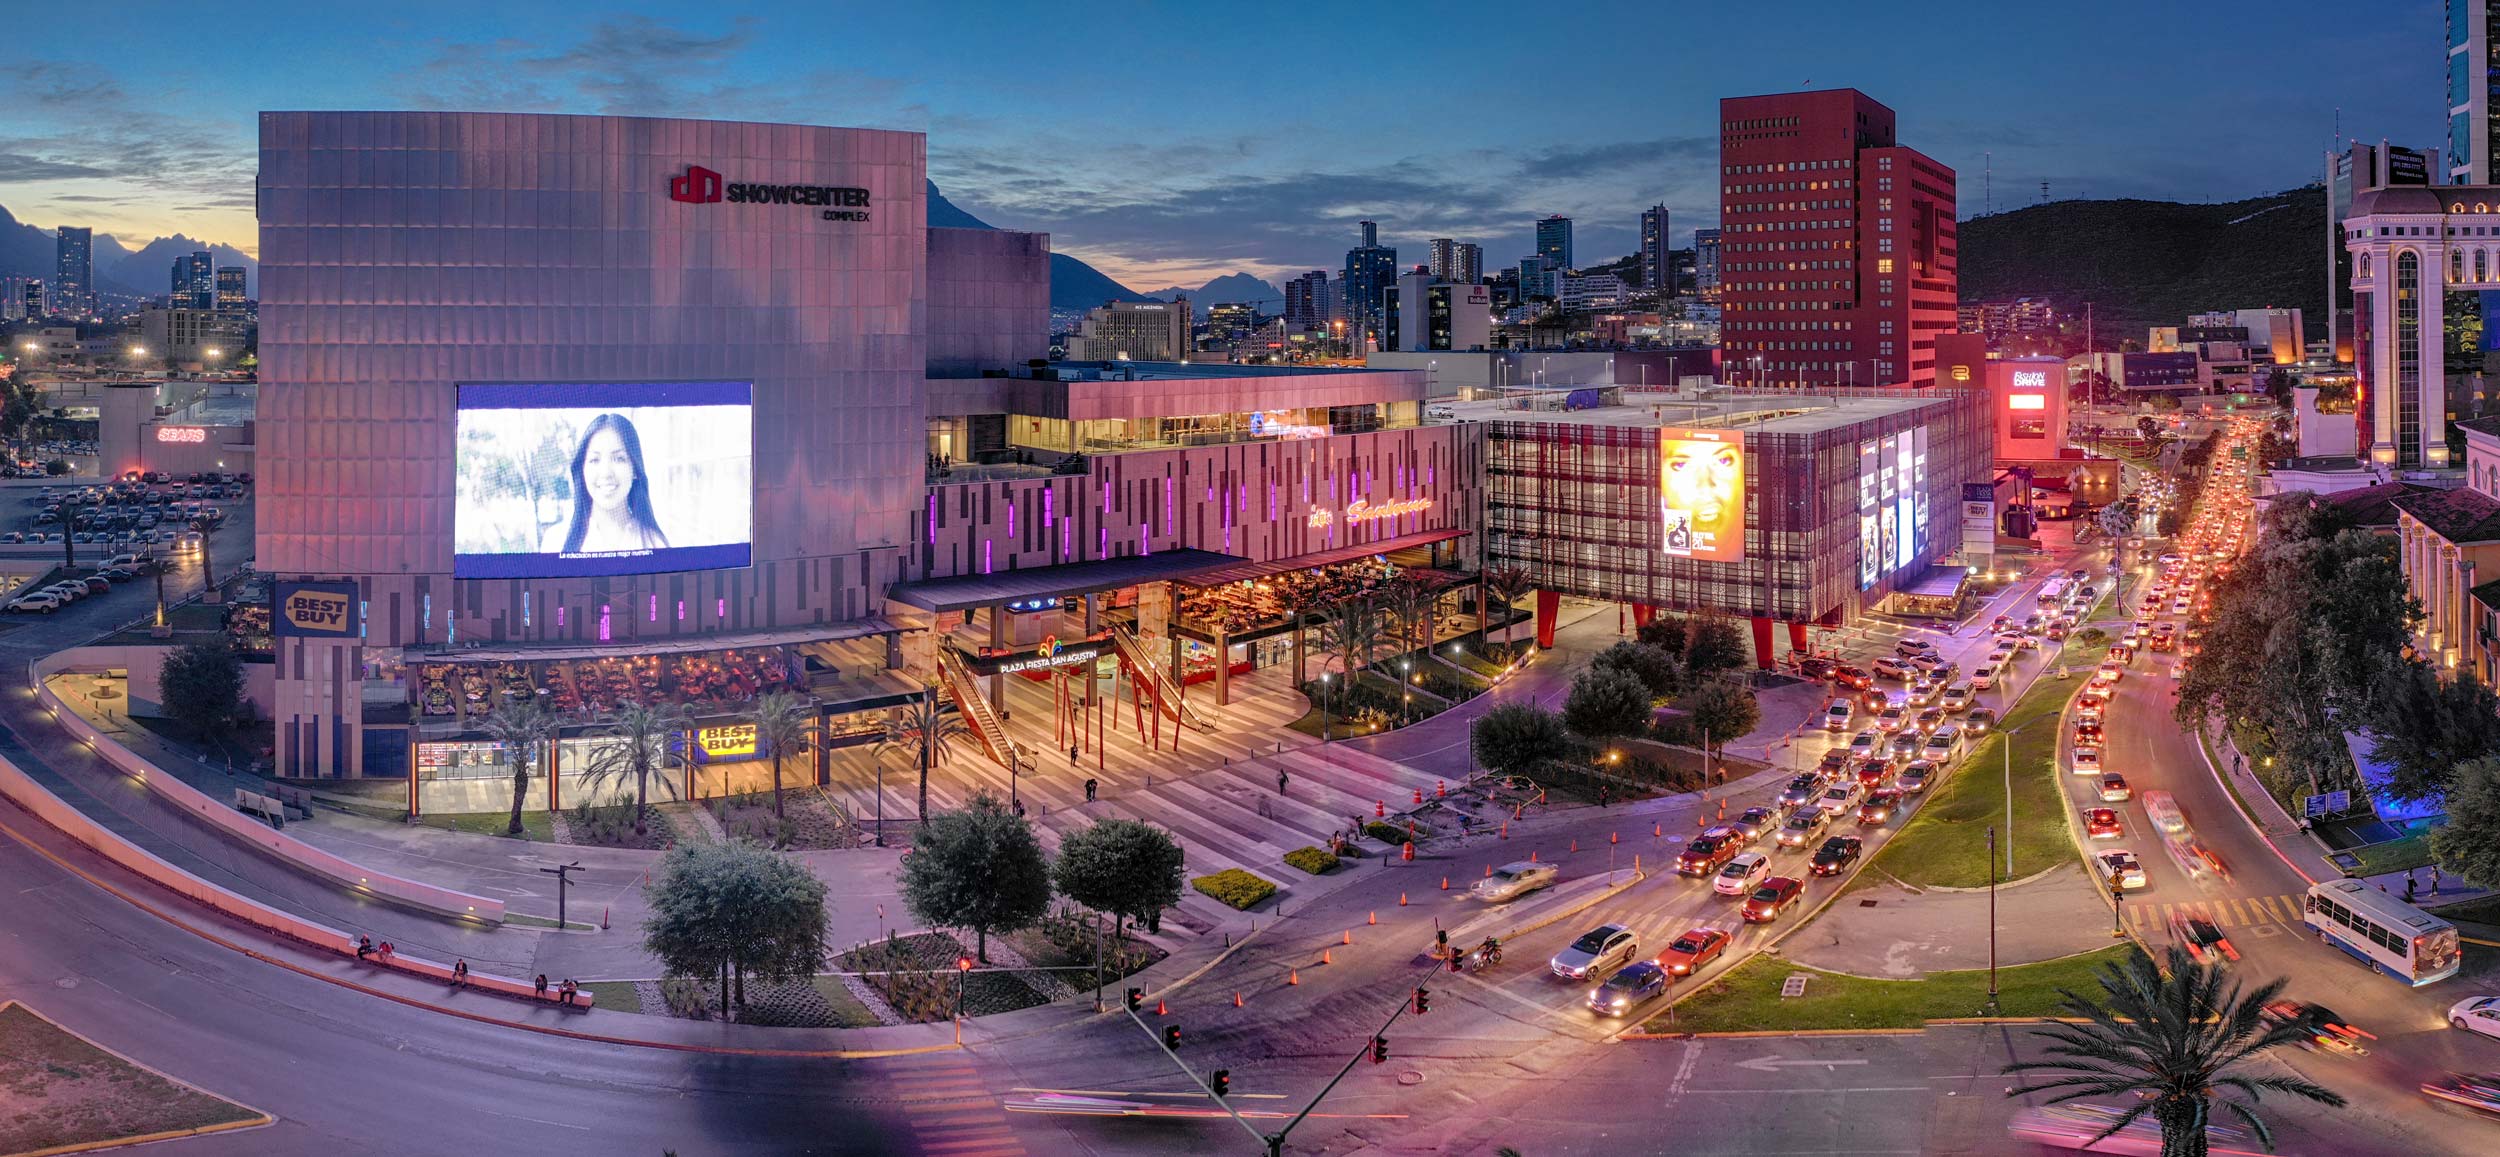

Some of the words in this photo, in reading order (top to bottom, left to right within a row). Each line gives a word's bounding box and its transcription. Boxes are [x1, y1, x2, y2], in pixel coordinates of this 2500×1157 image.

[727, 183, 871, 207] SHOWCENTER
[823, 210, 870, 222] COMPLEX
[2013, 379, 2046, 387] DRIVE
[2014, 371, 2046, 380] FASHION
[158, 427, 205, 443] SEARS
[1347, 498, 1433, 523] Sanborns
[293, 597, 346, 613] BEST
[295, 610, 341, 625] BUY
[1000, 661, 1026, 674] PLAZA
[1026, 658, 1051, 670] FIESTA
[1051, 655, 1068, 666] SAN
[1067, 650, 1097, 663] AGUSTIN
[706, 726, 754, 739] BEST
[707, 738, 750, 750] BUY
